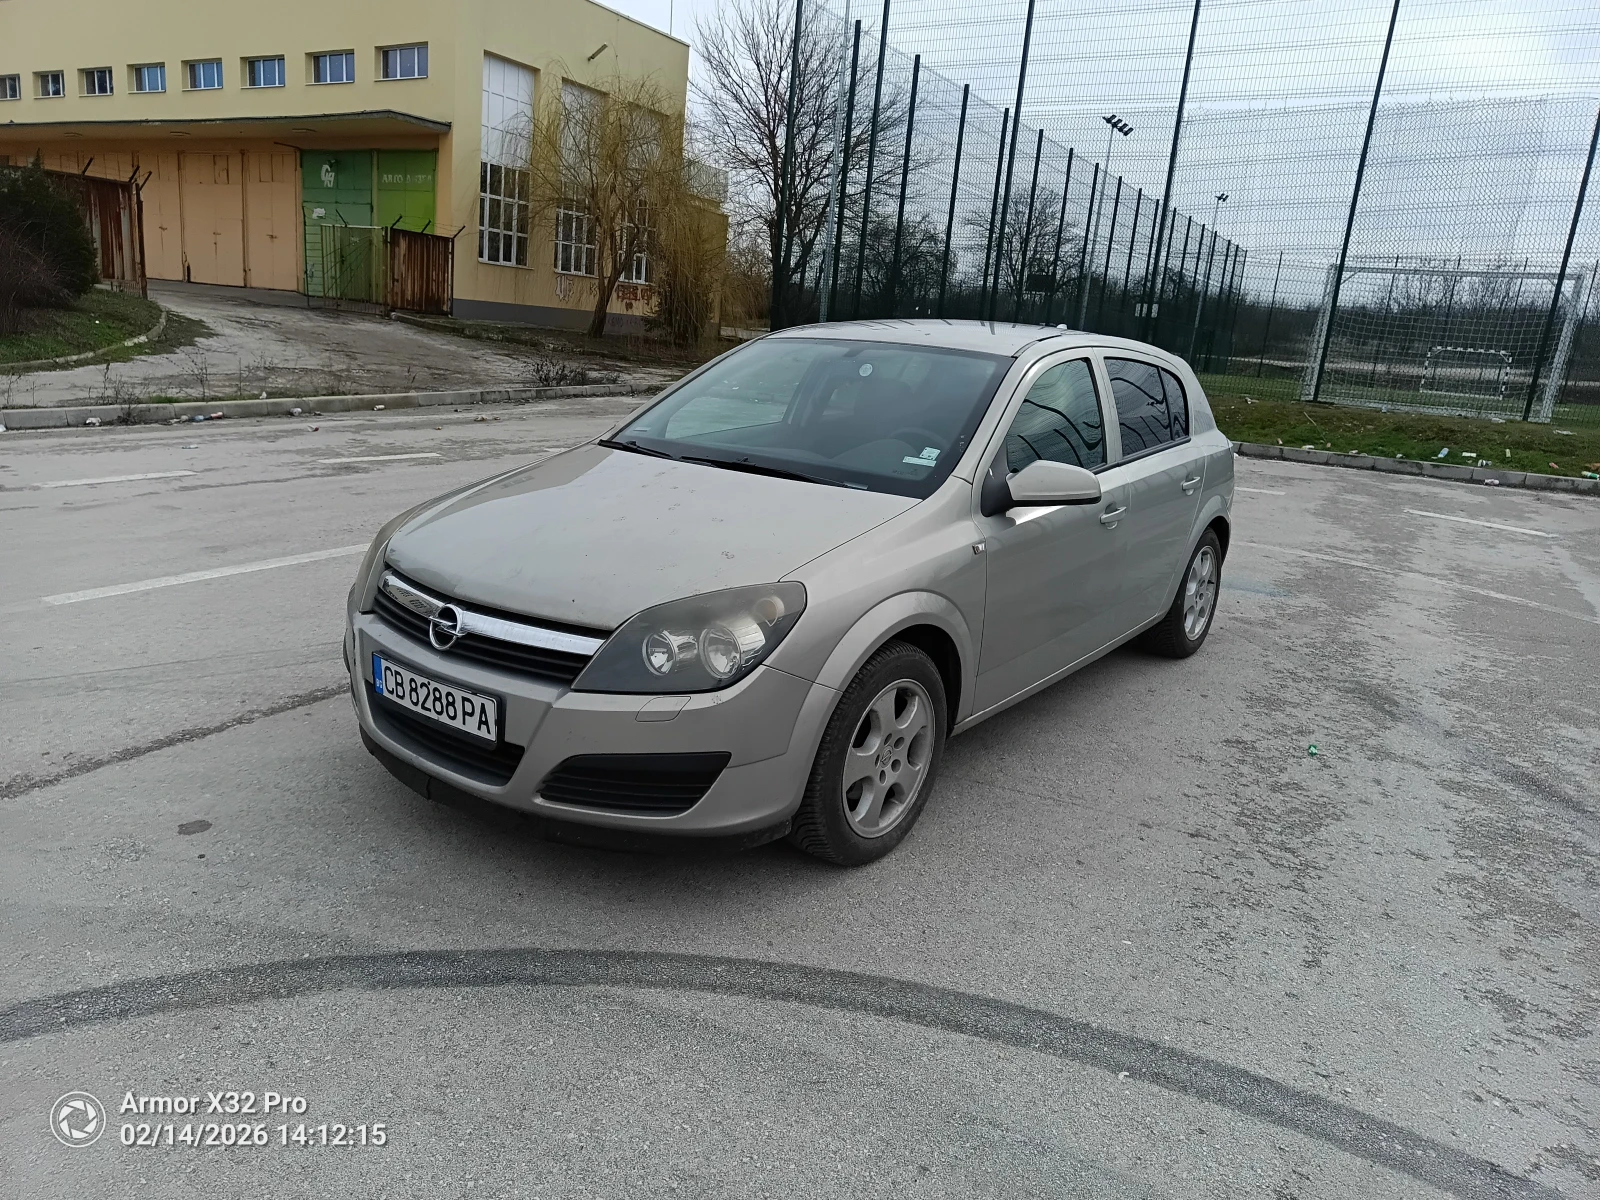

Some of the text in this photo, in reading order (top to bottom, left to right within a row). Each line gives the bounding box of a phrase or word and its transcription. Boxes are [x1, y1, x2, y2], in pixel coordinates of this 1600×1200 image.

[384, 665, 491, 735] CB 8288 PA
